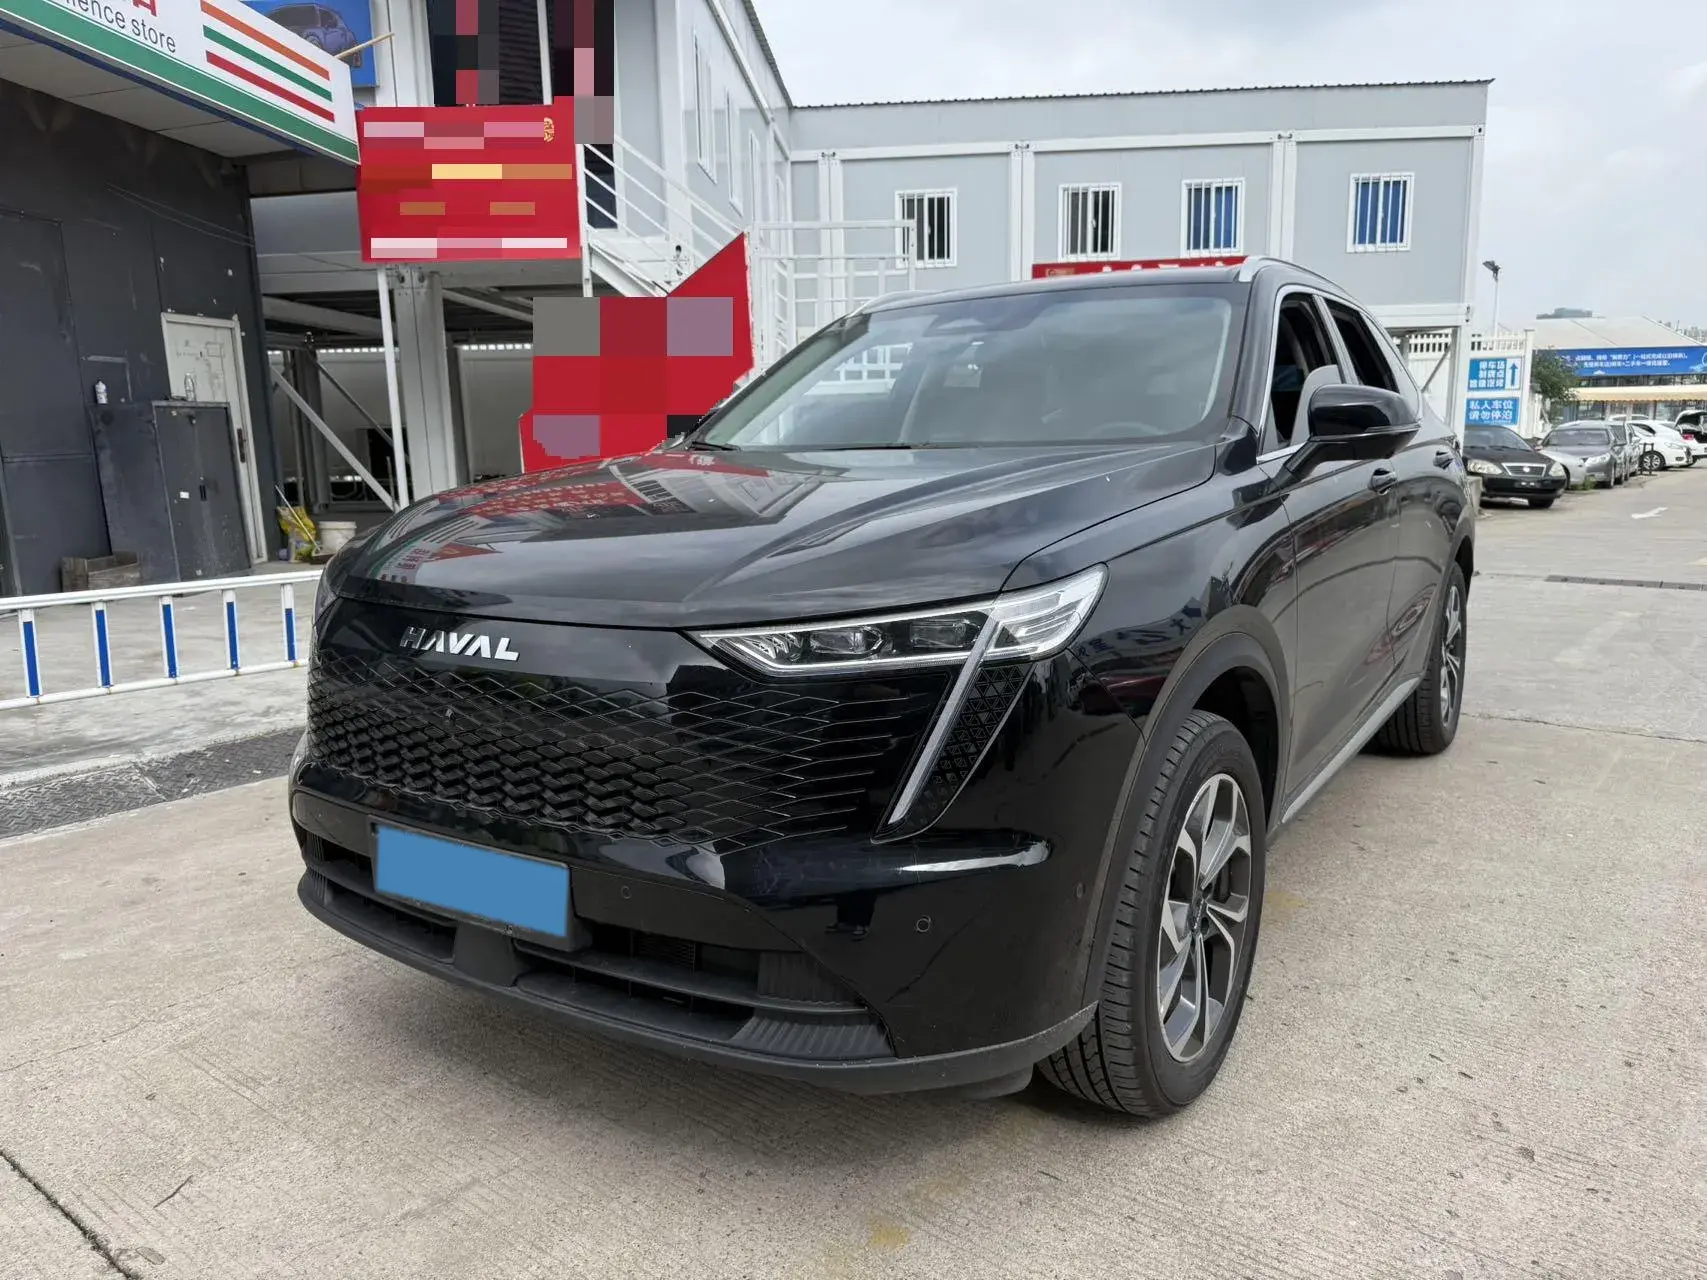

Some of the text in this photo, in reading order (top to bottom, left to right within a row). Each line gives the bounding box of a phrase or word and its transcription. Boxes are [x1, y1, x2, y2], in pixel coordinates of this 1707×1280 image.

[66, 0, 126, 29] ence
[131, 18, 177, 53] store
[1469, 400, 1513, 410] 私人车位
[1469, 410, 1513, 420] 请勿停泊
[400, 626, 519, 661] HAVAL
